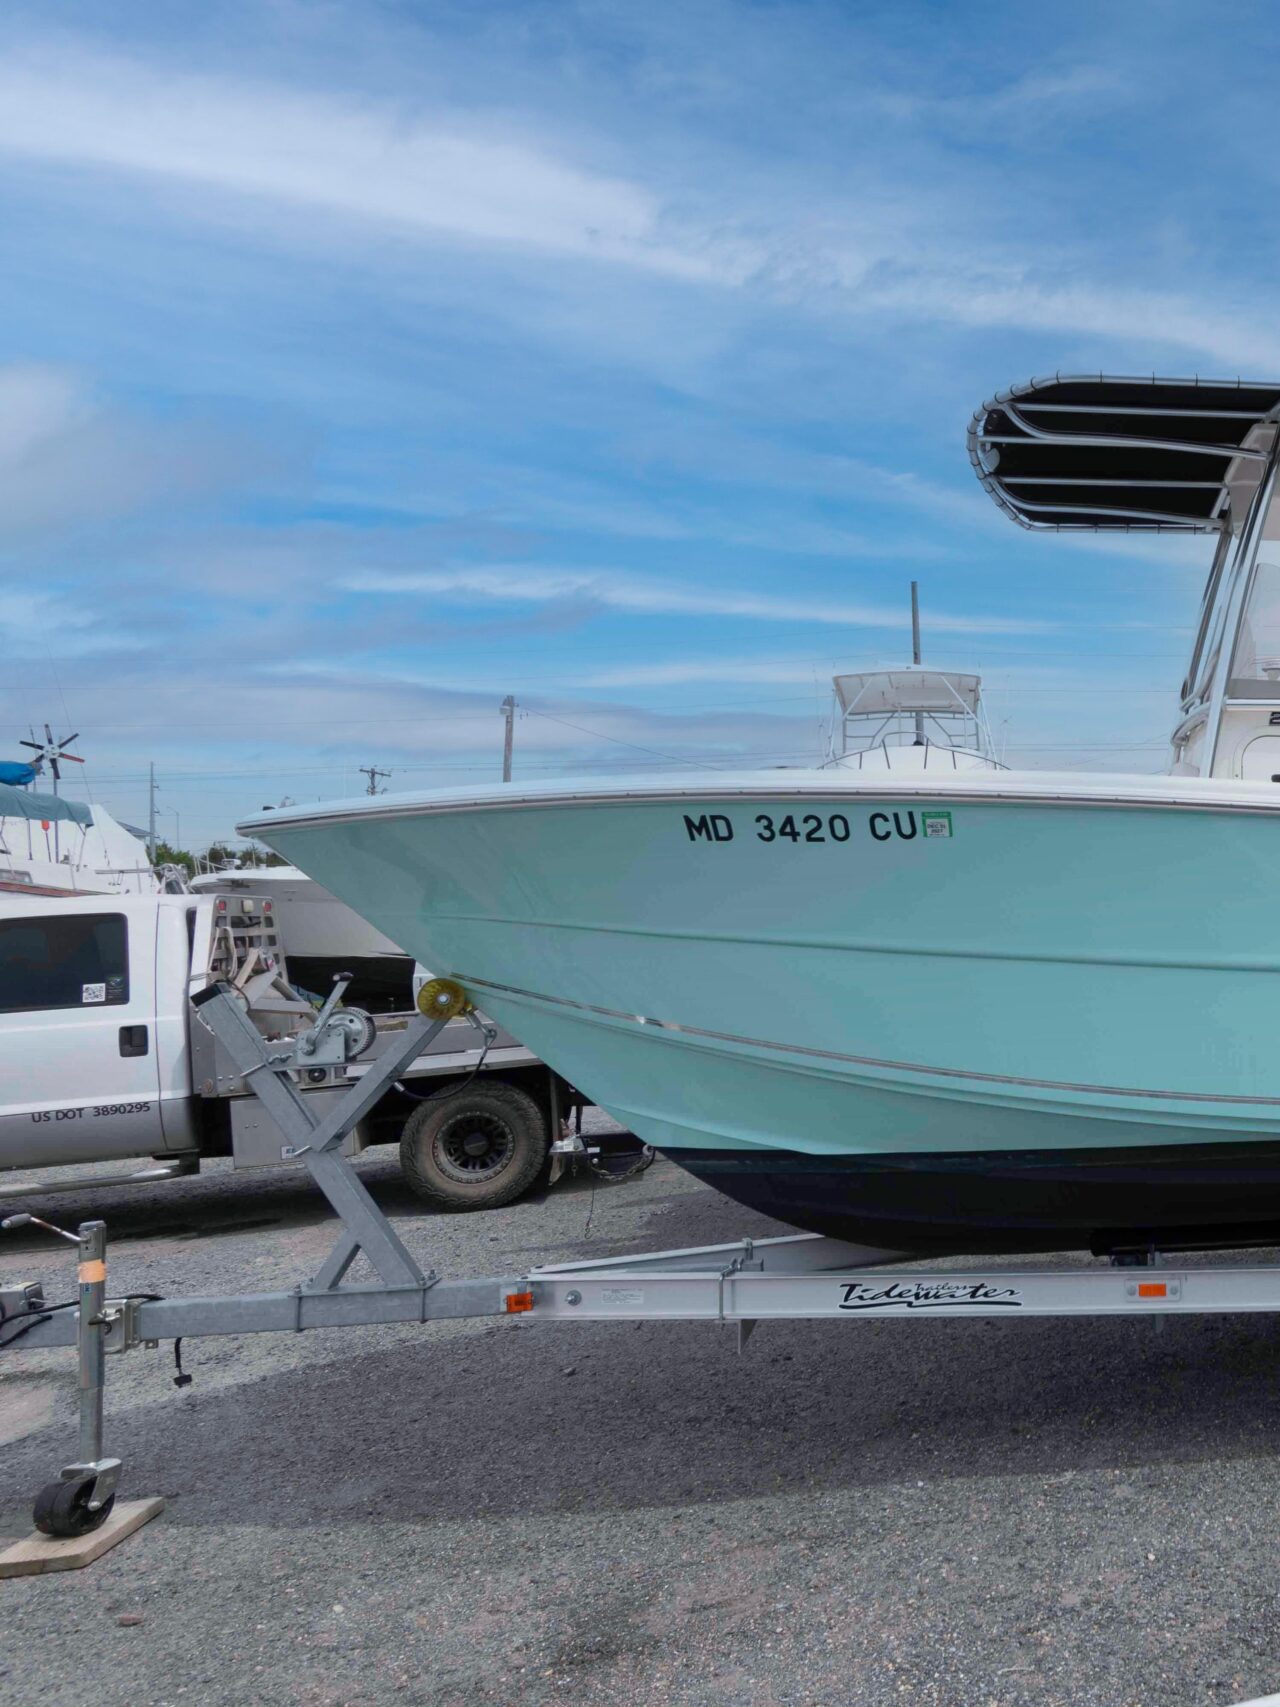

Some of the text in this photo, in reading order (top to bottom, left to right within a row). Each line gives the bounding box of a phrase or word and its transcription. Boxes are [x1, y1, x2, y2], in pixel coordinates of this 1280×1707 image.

[683, 811, 918, 843] MD 3420 CU
[31, 1102, 151, 1123] US DOT 3890295
[839, 1282, 1021, 1303] Tidewater
